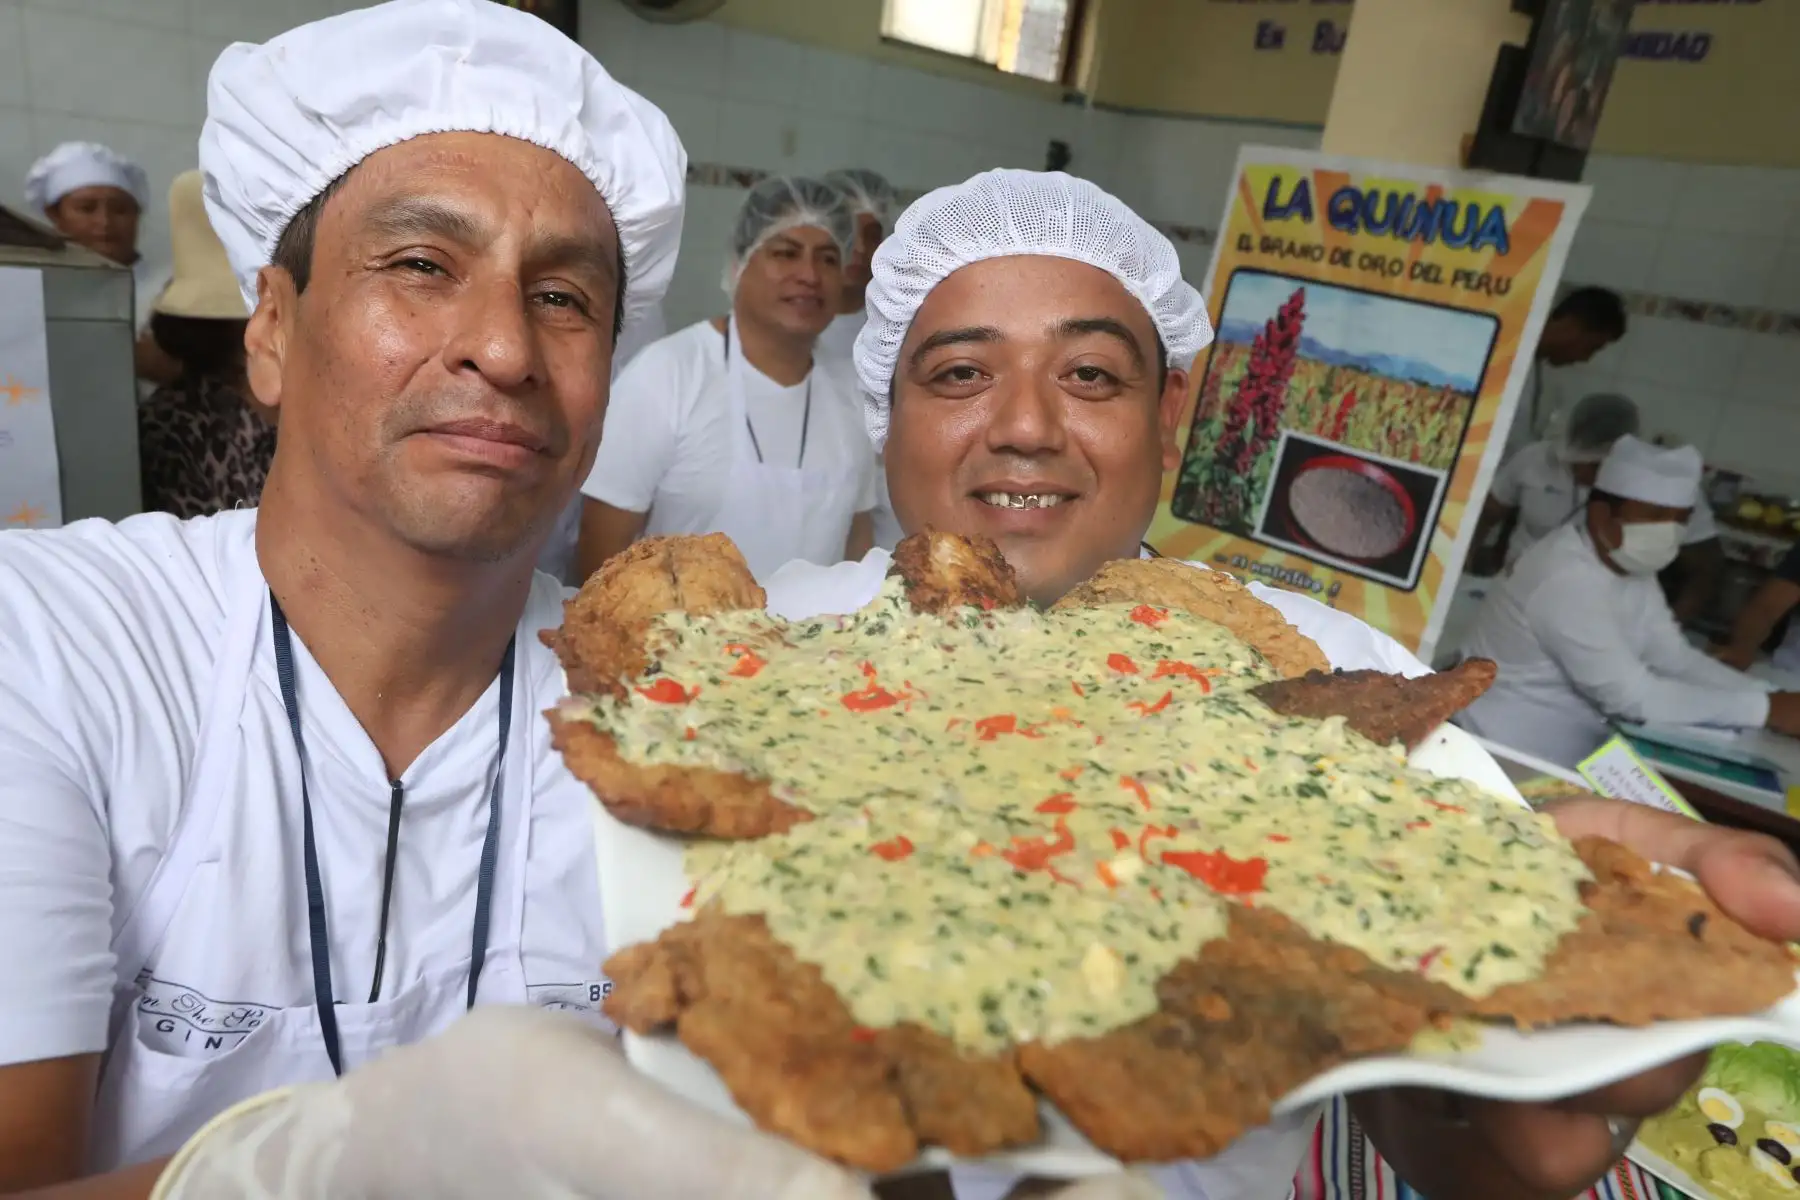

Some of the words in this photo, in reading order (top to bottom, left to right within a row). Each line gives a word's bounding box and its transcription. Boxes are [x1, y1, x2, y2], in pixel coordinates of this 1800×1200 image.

[1262, 174, 1314, 224] LA
[1328, 185, 1510, 256] QUINUA
[1236, 233, 1253, 253] EL
[1329, 246, 1354, 268] DE
[1358, 251, 1404, 278] ORO
[1411, 261, 1443, 284] DEL
[1451, 267, 1512, 297] PERU
[171, 993, 214, 1025] The
